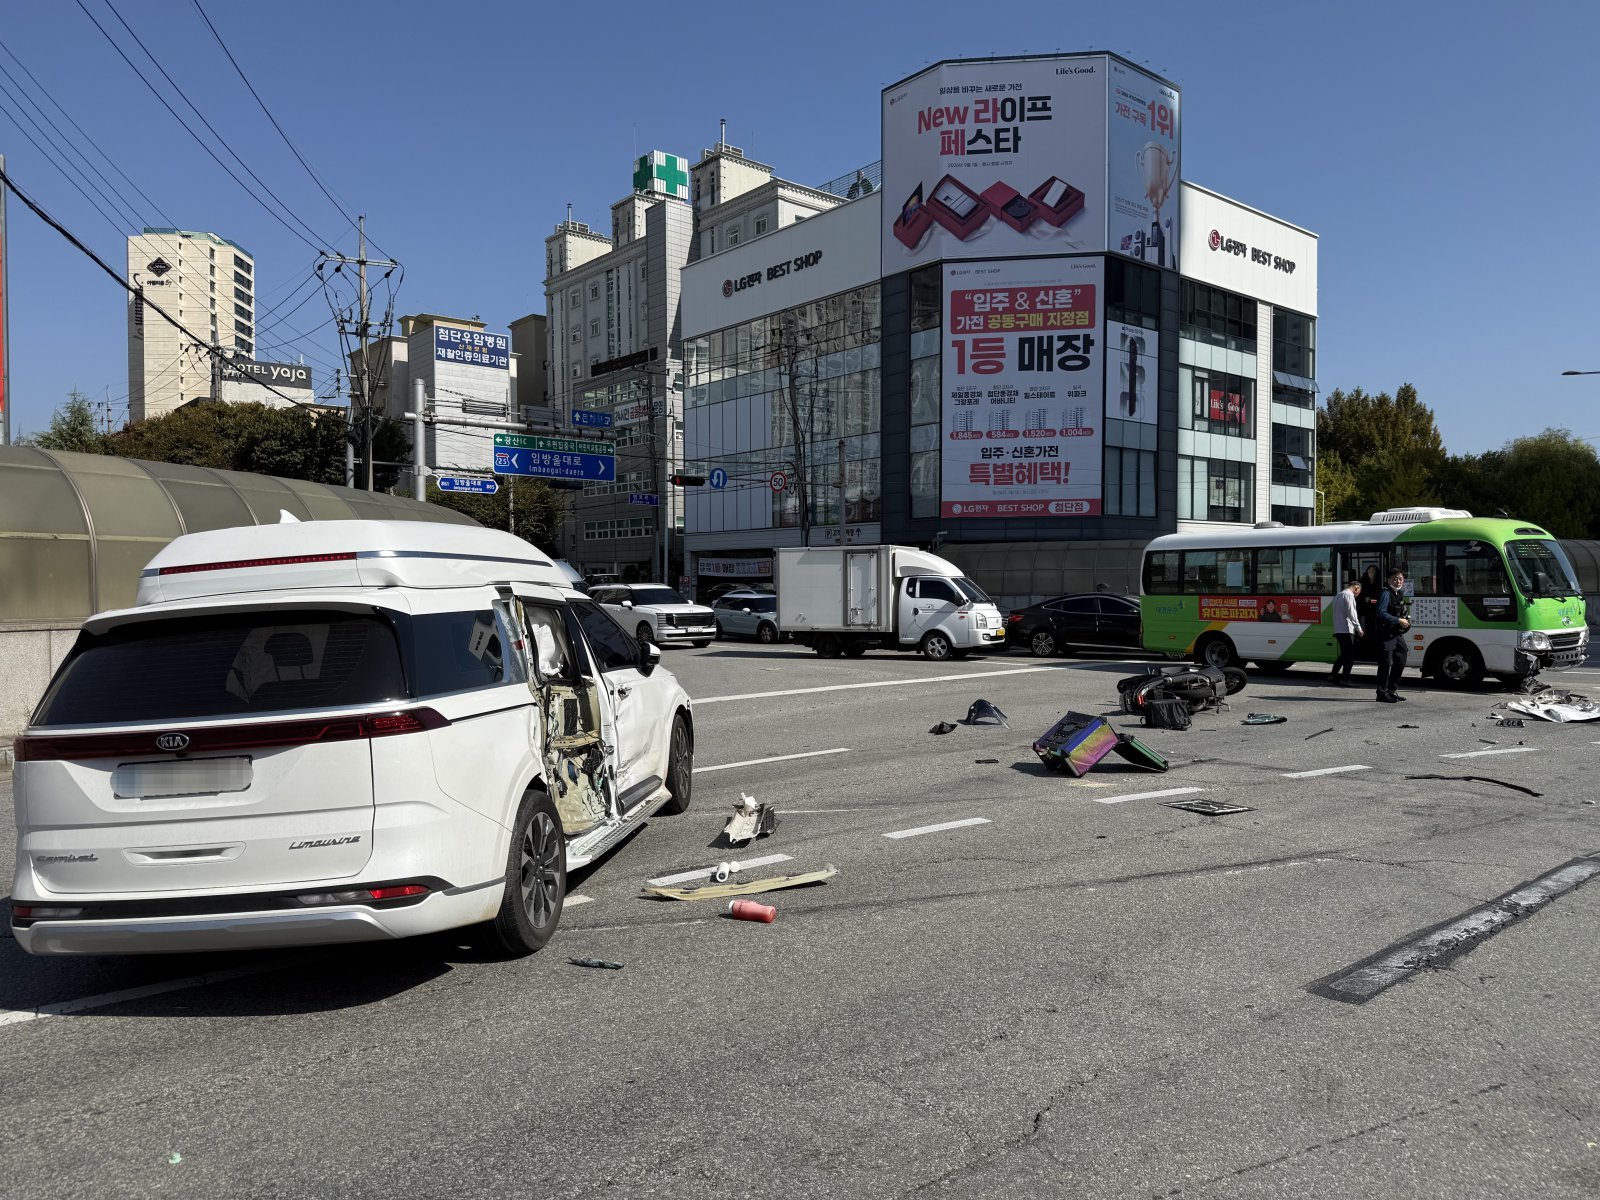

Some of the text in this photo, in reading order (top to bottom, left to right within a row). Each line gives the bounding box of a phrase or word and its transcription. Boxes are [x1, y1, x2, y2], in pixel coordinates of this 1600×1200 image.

[1074, 66, 1096, 75] Good.
[940, 83, 1022, 95] 일상을 바꾸는 새로운 가전
[918, 96, 1052, 134] New 라이프
[1115, 100, 1174, 139] 가전 구독 1위
[940, 126, 1022, 156] 페스타
[767, 260, 792, 281] BEST
[793, 250, 823, 272] SHOP
[1251, 247, 1273, 267] BEST
[1273, 255, 1296, 275] SHOP
[1015, 291, 1030, 310] &
[956, 311, 1089, 330] 가전 공동구매 지정점
[438, 328, 506, 350] 첨단우암병원
[437, 347, 508, 366] 재활인증의료기관
[952, 333, 1095, 375] 1등 매장
[270, 366, 307, 382] yaja
[504, 436, 527, 446] 광산IC
[546, 440, 575, 451] 우편집중국
[531, 453, 582, 466] 임방울대로
[529, 465, 584, 476] Imbangul-daero
[969, 462, 1071, 486] 특별혜택!
[453, 479, 482, 487] 임방울대로
[773, 477, 783, 486] 50
[963, 504, 989, 513] LG전자
[1020, 504, 1044, 512] SHOP
[1054, 502, 1084, 513] 첨단점
[1202, 607, 1259, 619] 휴대폰파괴자
[160, 736, 184, 748] KIA
[288, 835, 361, 850] Limousine
[36, 853, 98, 863] Carnival
